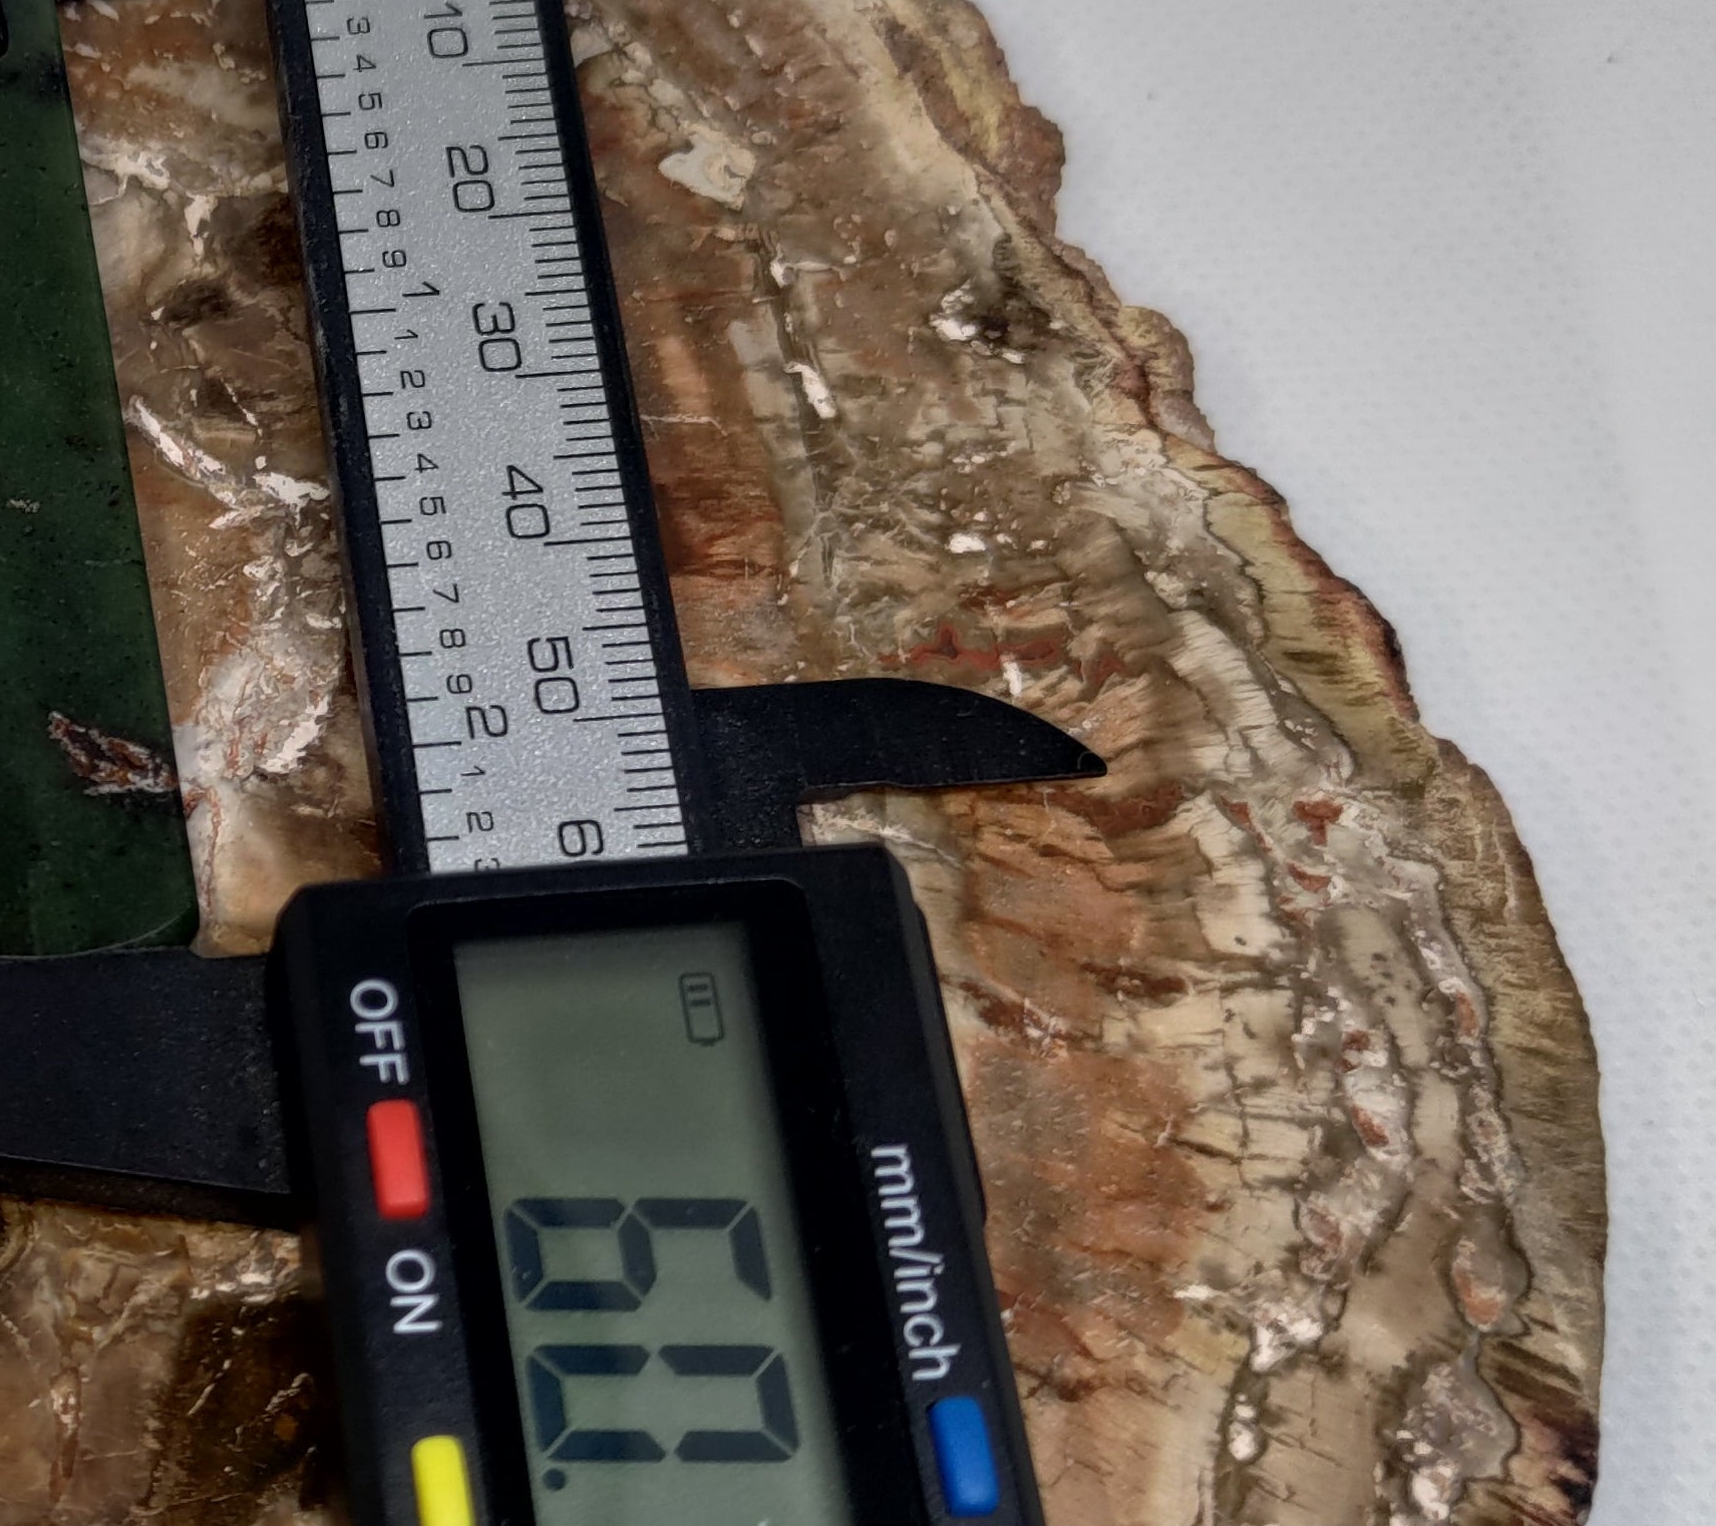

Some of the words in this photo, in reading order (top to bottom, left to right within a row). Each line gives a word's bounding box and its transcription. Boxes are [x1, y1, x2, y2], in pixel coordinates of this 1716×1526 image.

[346, 17, 371, 35] 3
[353, 54, 377, 73] 4
[358, 92, 383, 110] 5
[364, 131, 389, 150] 6
[370, 170, 395, 188] 7
[376, 209, 401, 228] 8
[382, 249, 407, 268] 9
[402, 281, 440, 297] 1
[394, 329, 419, 340] 1
[400, 370, 426, 389] 2
[406, 411, 433, 431] 3
[423, 0, 469, 59] 10
[446, 144, 495, 213] 20
[472, 301, 522, 372] 30
[501, 464, 550, 539] 40
[526, 636, 580, 714] 50
[557, 819, 604, 857] 6
[414, 453, 440, 473] 4
[419, 496, 446, 516] 5
[426, 540, 453, 560] 6
[433, 583, 460, 603] 7
[439, 628, 466, 649] 8
[445, 674, 473, 694] 9
[465, 704, 508, 740] 2
[460, 765, 486, 777] 1
[467, 810, 494, 833] 2
[349, 978, 410, 1085] OFF
[871, 1143, 961, 1381] mm/inch
[385, 1248, 443, 1334] ON
